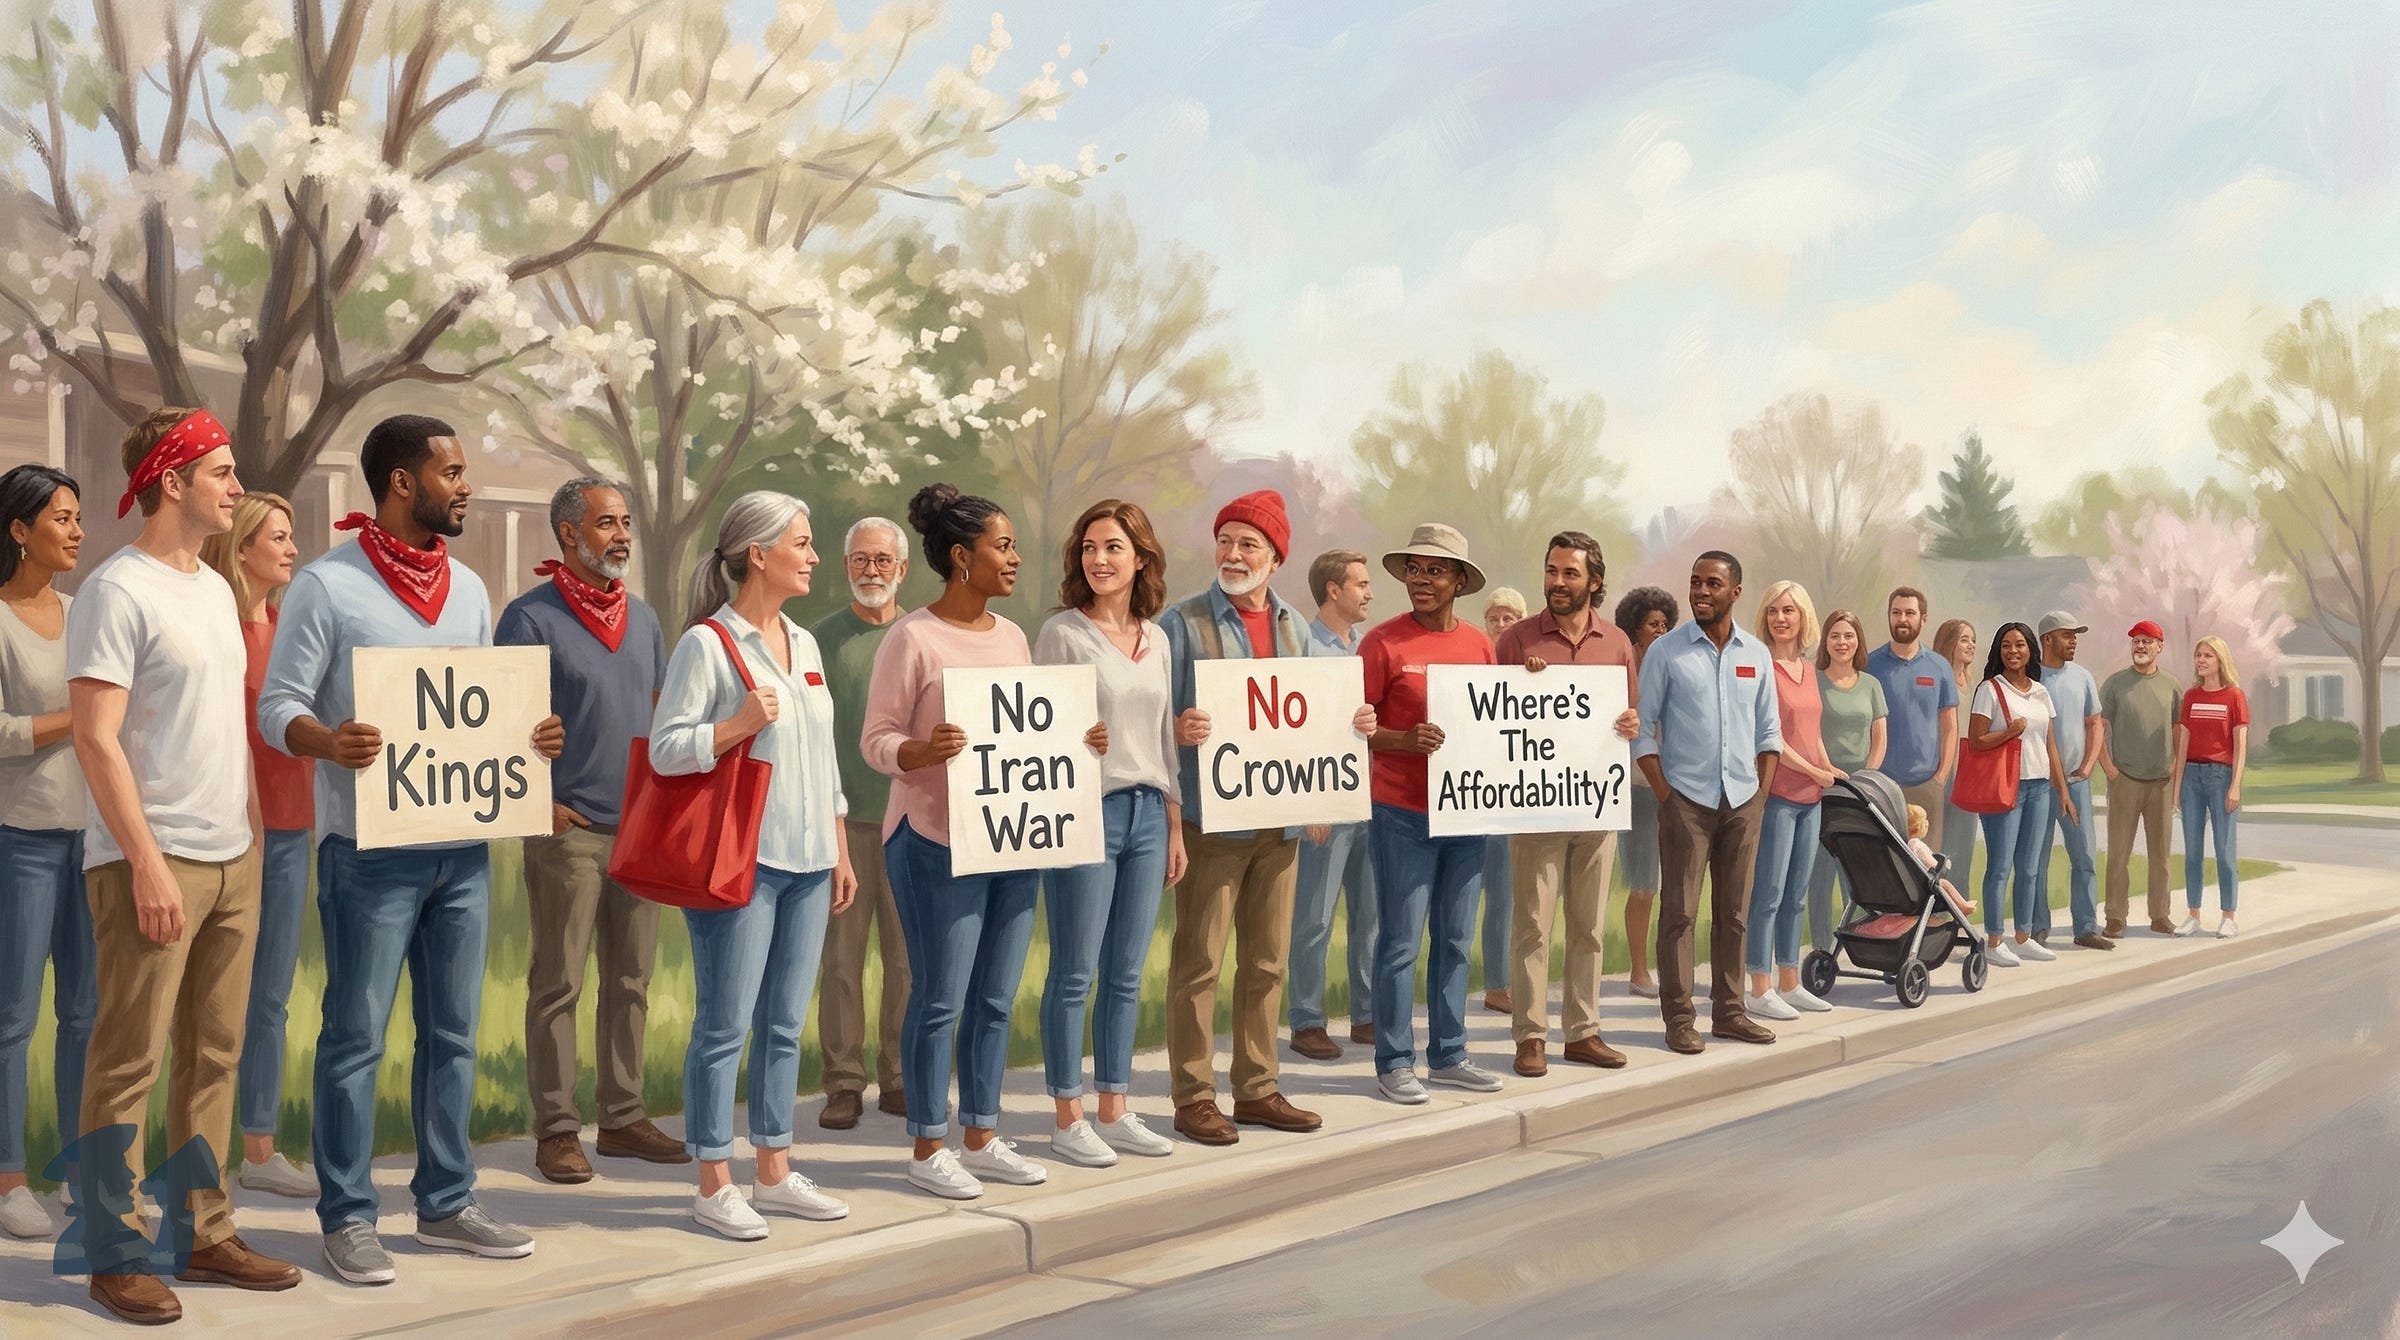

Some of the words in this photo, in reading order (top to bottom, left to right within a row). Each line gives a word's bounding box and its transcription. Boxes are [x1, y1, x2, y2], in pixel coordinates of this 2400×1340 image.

[415, 665, 490, 731] No
[991, 681, 1054, 734] No
[1246, 674, 1308, 732] No
[1467, 681, 1591, 722] Where's
[972, 743, 1075, 796] Iran
[1211, 742, 1360, 801] Crowns
[1499, 728, 1556, 762] The
[386, 742, 528, 824] Kings
[1437, 763, 1626, 819] Affordability?
[981, 801, 1075, 854] War
